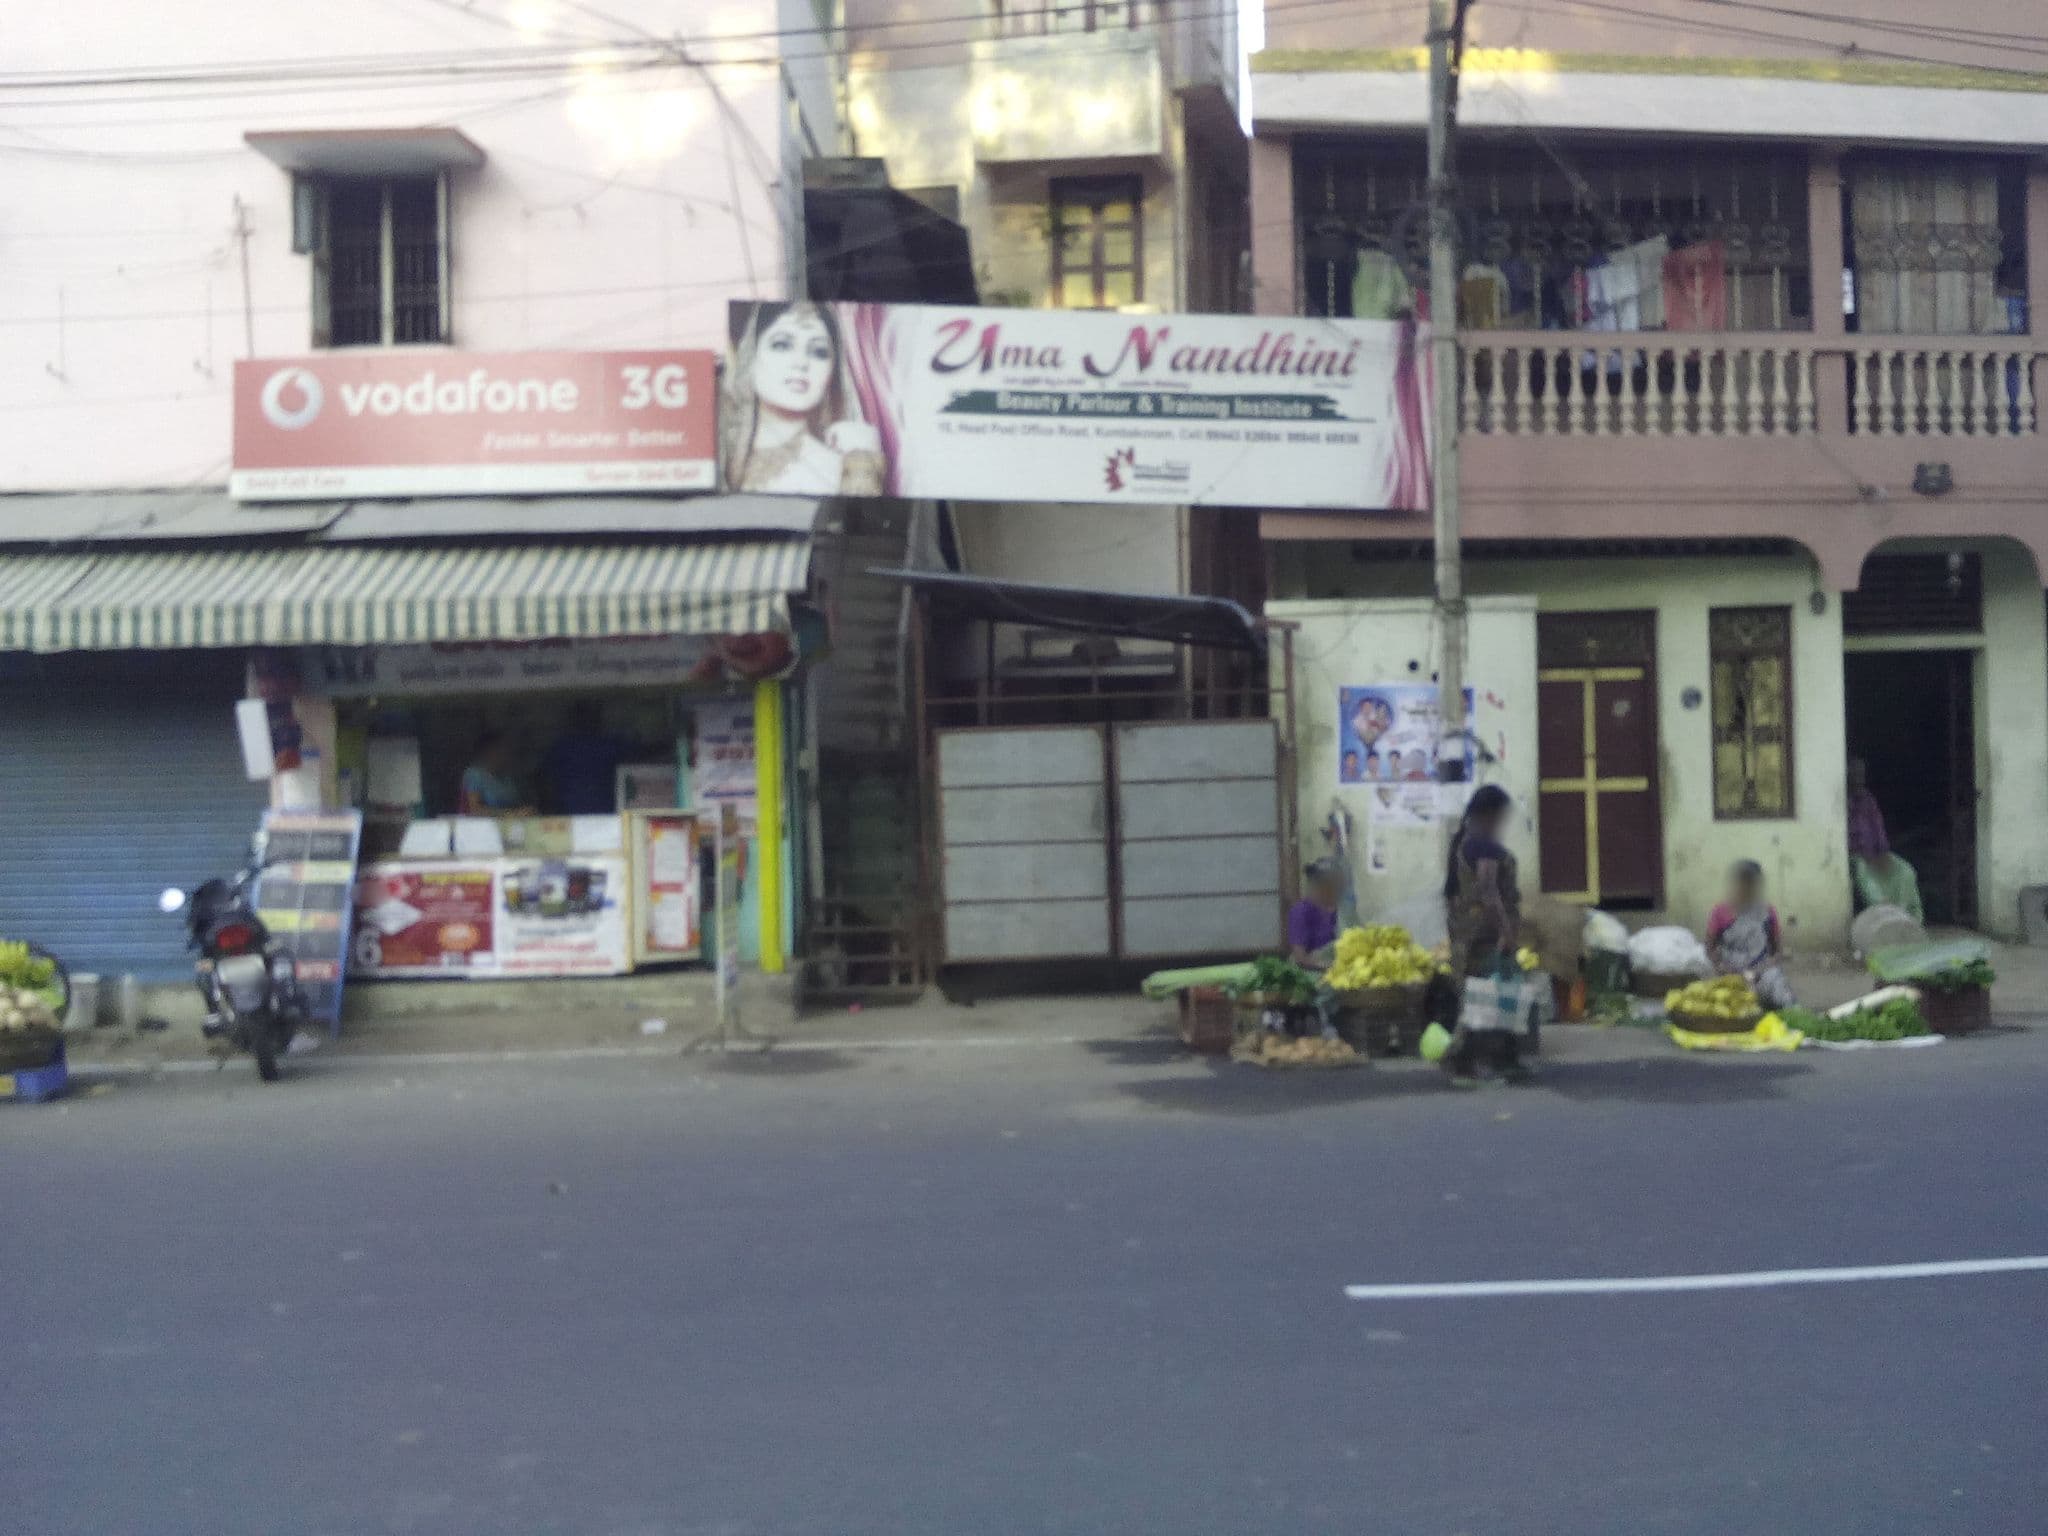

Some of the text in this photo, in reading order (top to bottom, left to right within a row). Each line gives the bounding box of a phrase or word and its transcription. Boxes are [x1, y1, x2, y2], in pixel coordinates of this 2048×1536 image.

[931, 317, 1363, 380] Uma Nandhini
[340, 363, 689, 417] vodafone 3G
[996, 391, 1062, 415] Beauty
[1136, 394, 1154, 413] &
[1161, 393, 1231, 418] Training
[1235, 396, 1313, 418] Institute
